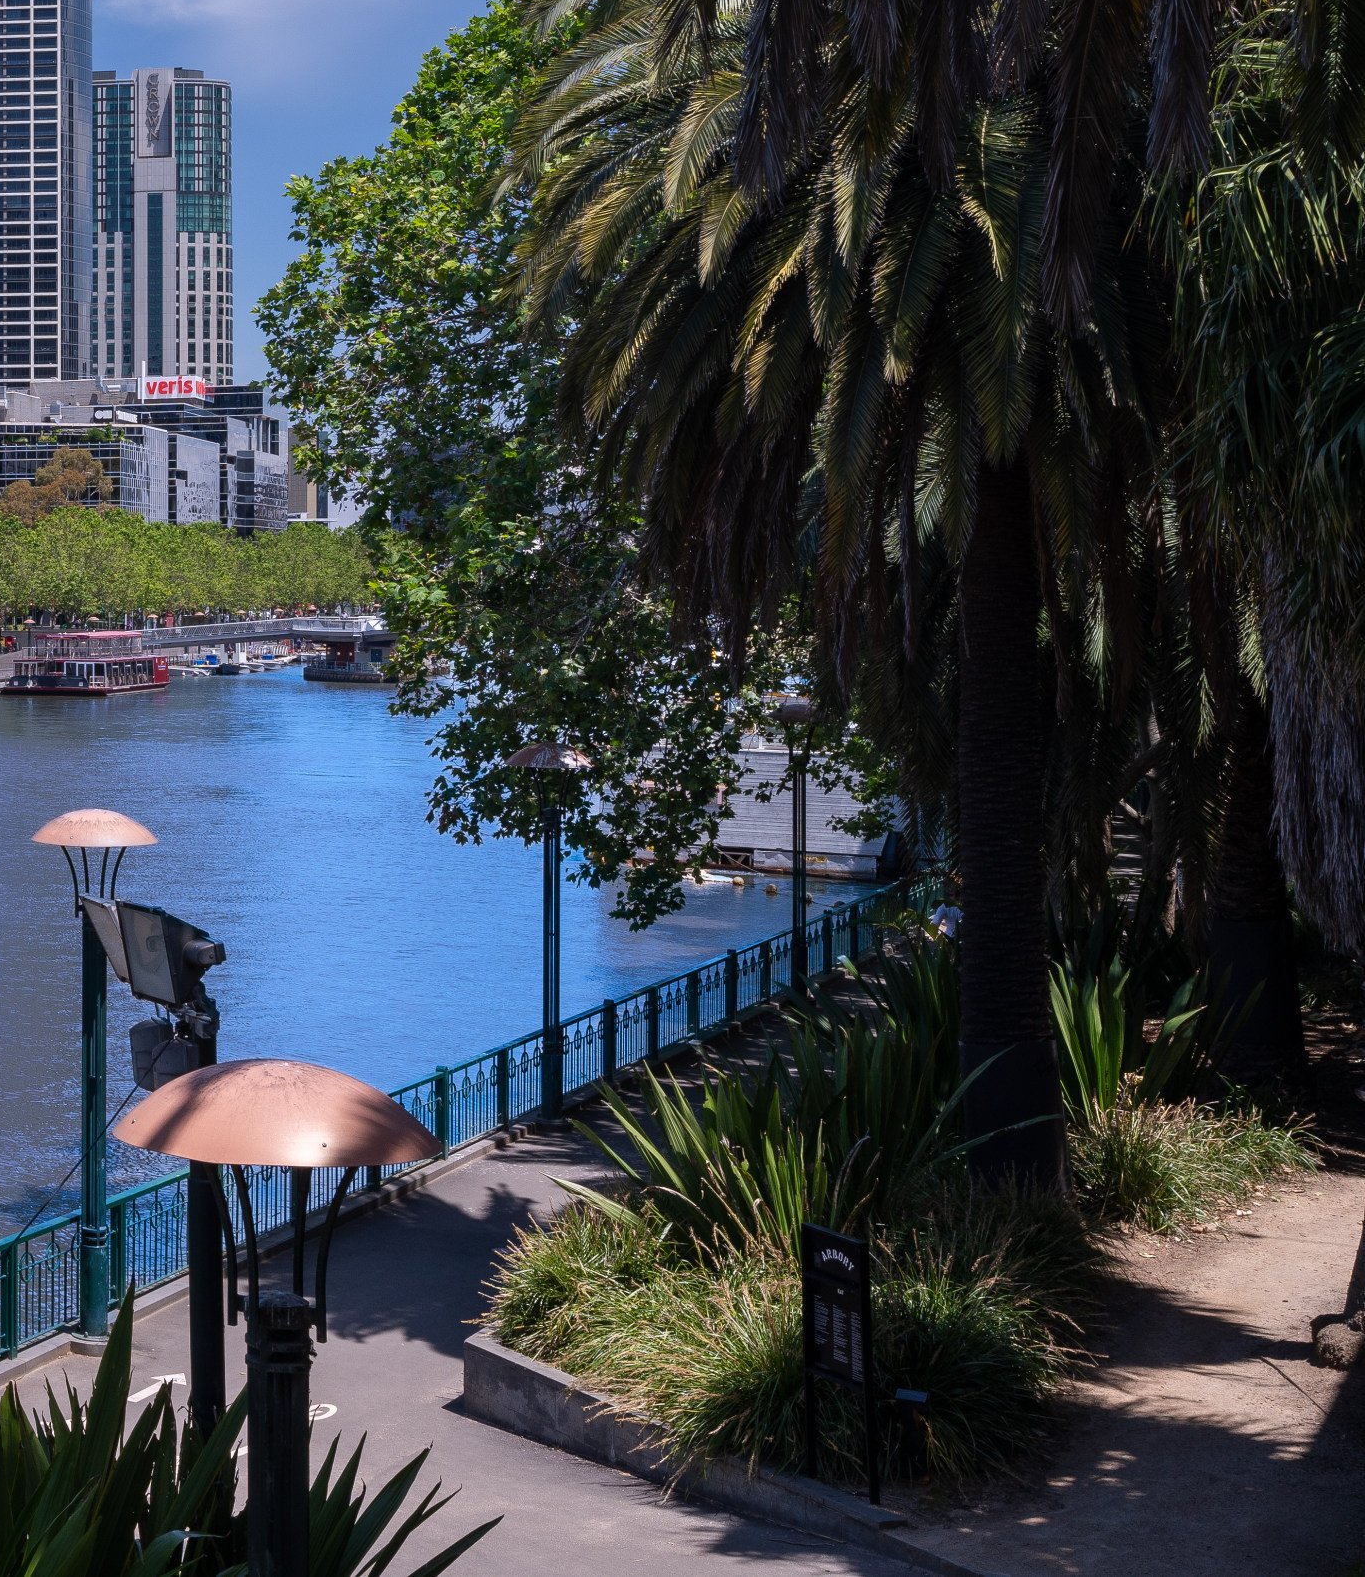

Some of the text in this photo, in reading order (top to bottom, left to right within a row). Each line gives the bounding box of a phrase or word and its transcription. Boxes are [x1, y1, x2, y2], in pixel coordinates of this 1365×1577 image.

[147, 72, 161, 143] CROWN
[146, 375, 194, 396] veris
[820, 1248, 855, 1271] ARBORY
